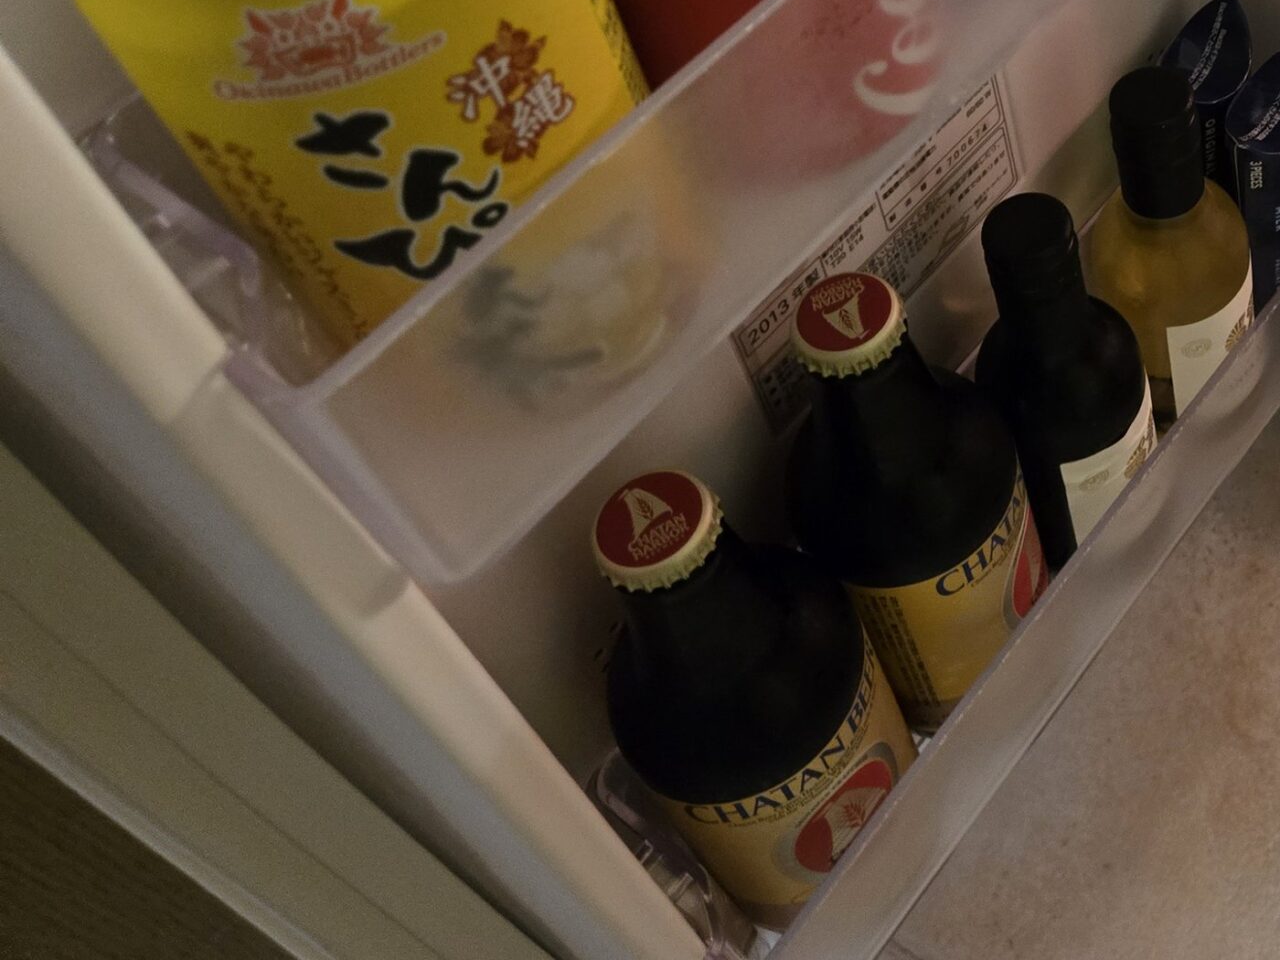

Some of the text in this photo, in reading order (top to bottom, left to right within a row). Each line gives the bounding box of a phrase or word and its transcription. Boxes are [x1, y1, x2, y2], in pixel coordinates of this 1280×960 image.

[448, 56, 574, 148] 沖縄
[810, 283, 865, 311] CHATAN
[746, 298, 791, 347] 2013
[627, 512, 689, 552] CHATAN
[684, 737, 846, 825] CHATAN
